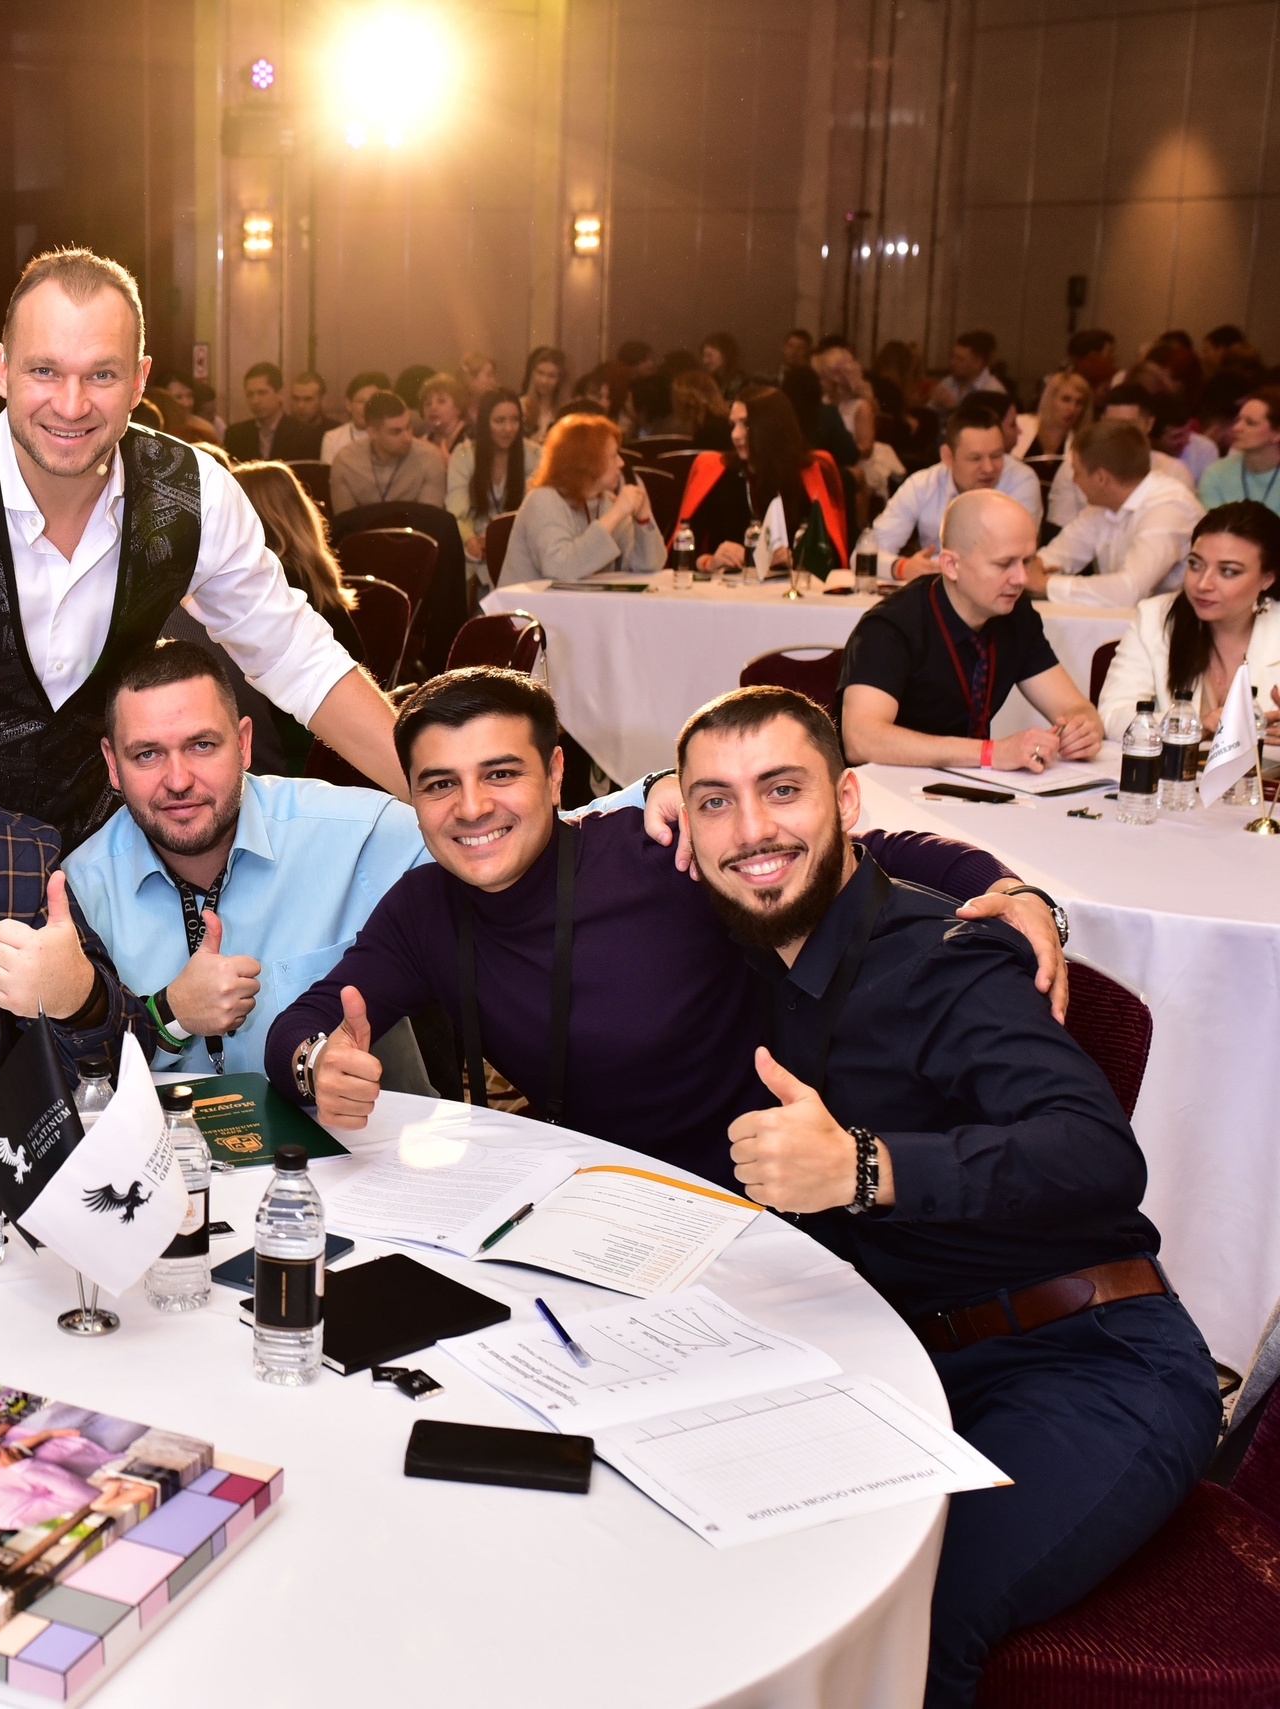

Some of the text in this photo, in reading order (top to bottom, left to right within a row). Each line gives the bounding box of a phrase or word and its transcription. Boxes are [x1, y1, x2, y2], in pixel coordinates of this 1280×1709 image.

[26, 1098, 65, 1140] TEMCHENKO
[199, 1100, 256, 1113] Модуль
[31, 1106, 72, 1150] PLATINUM
[35, 1129, 62, 1159] GROUP
[747, 1468, 938, 1522] УПРАВЛЕНИЕ НА ОСНОВЕ ТРЕНДОВ
